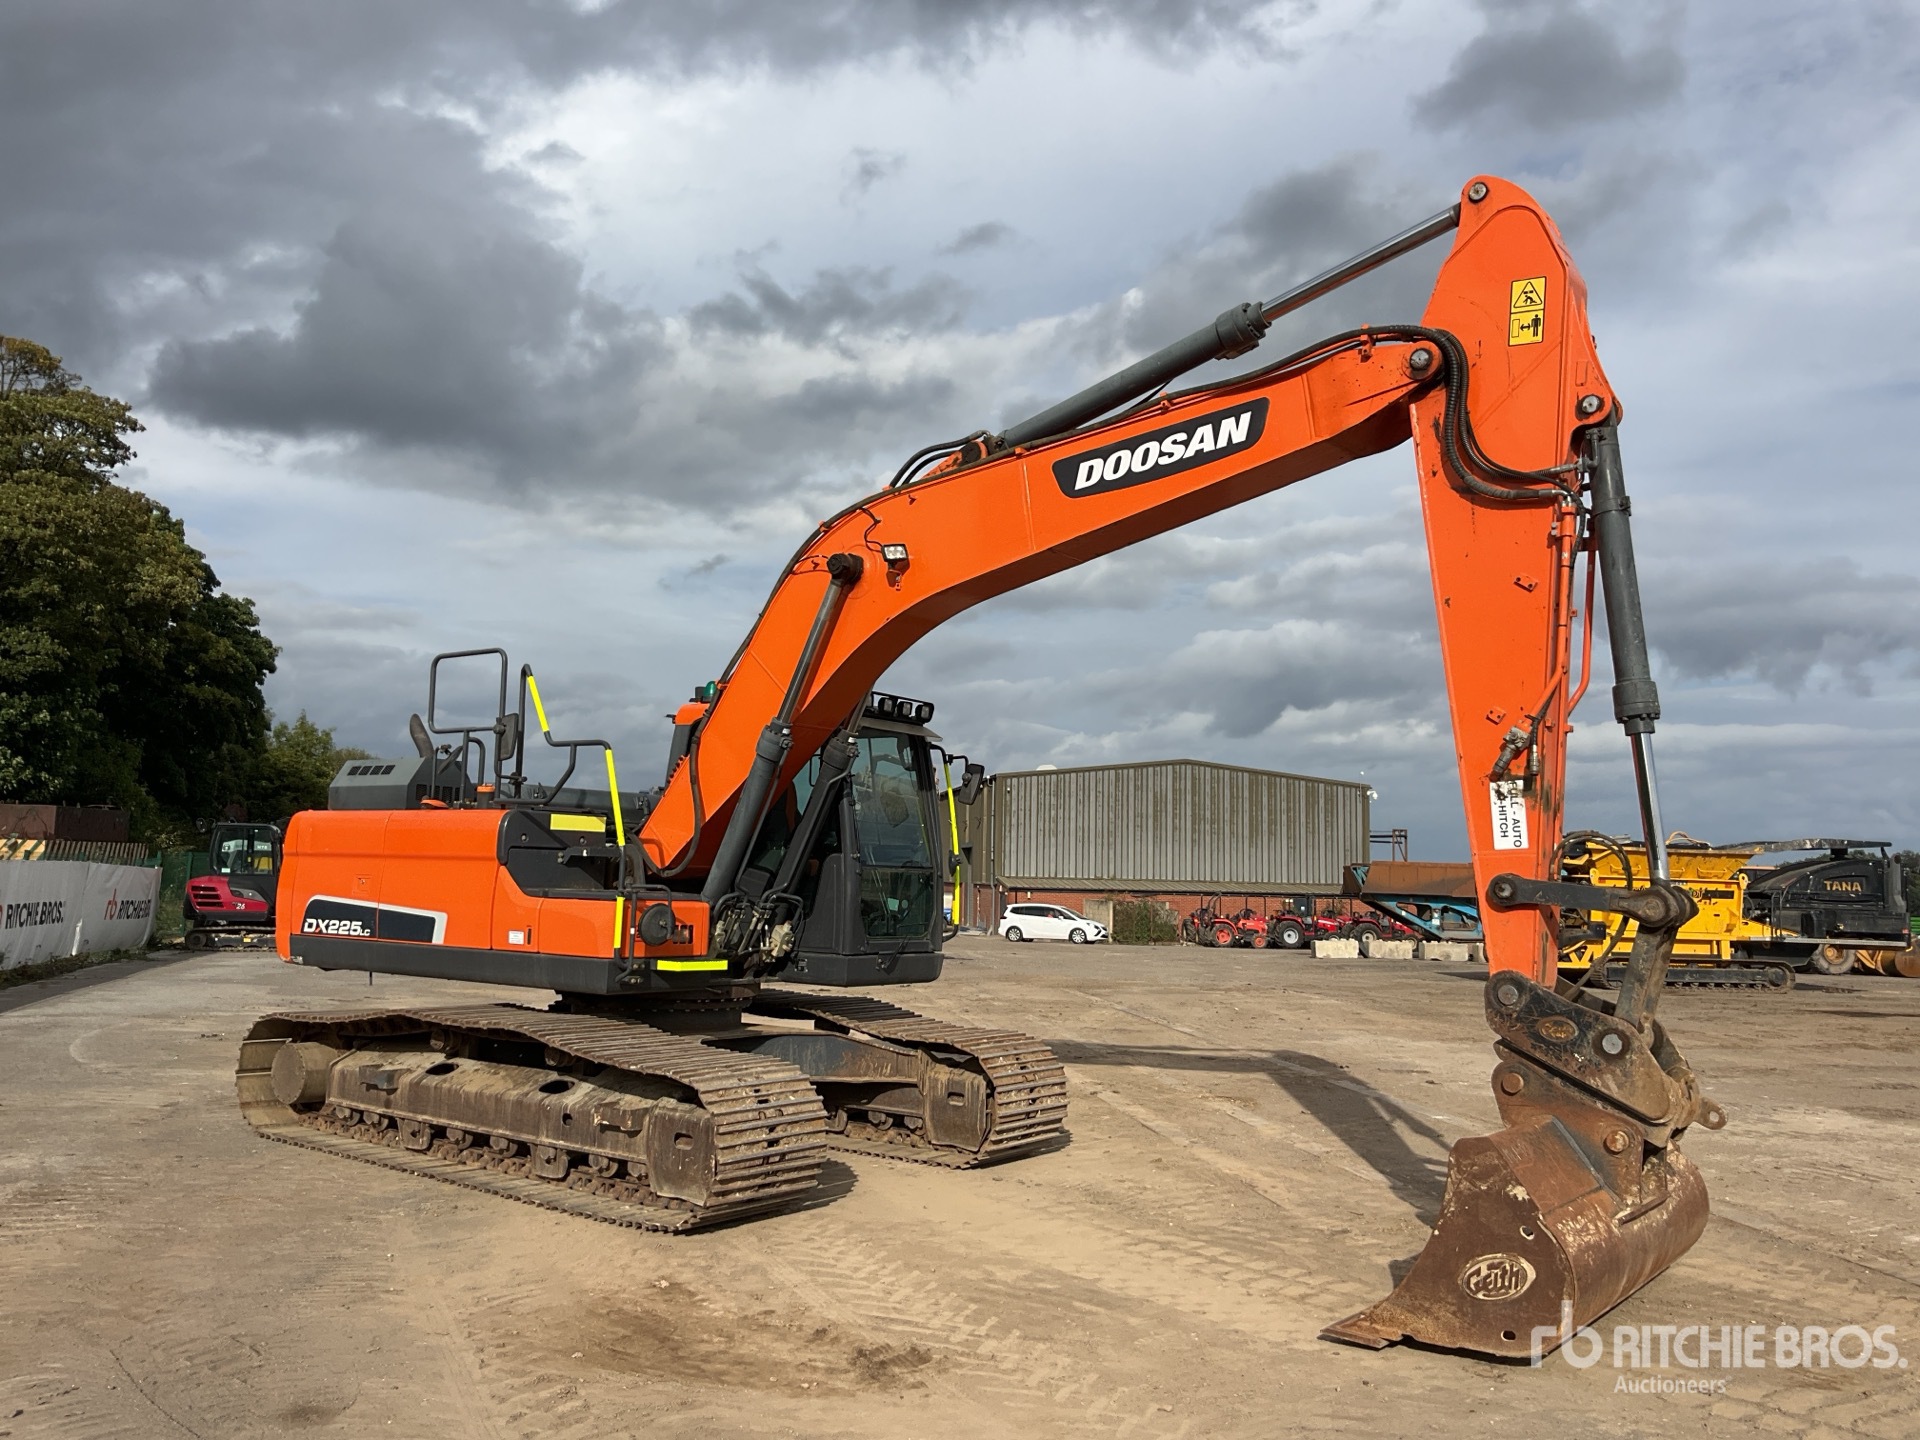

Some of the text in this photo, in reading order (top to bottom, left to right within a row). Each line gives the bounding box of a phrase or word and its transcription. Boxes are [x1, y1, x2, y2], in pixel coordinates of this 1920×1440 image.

[1074, 410, 1252, 490] DOOSAN
[1507, 781, 1519, 809] FULL
[1511, 818, 1522, 848] AUTO
[1823, 880, 1862, 892] TANA
[5, 901, 40, 929] RITCHIE
[39, 900, 64, 925] BROS.
